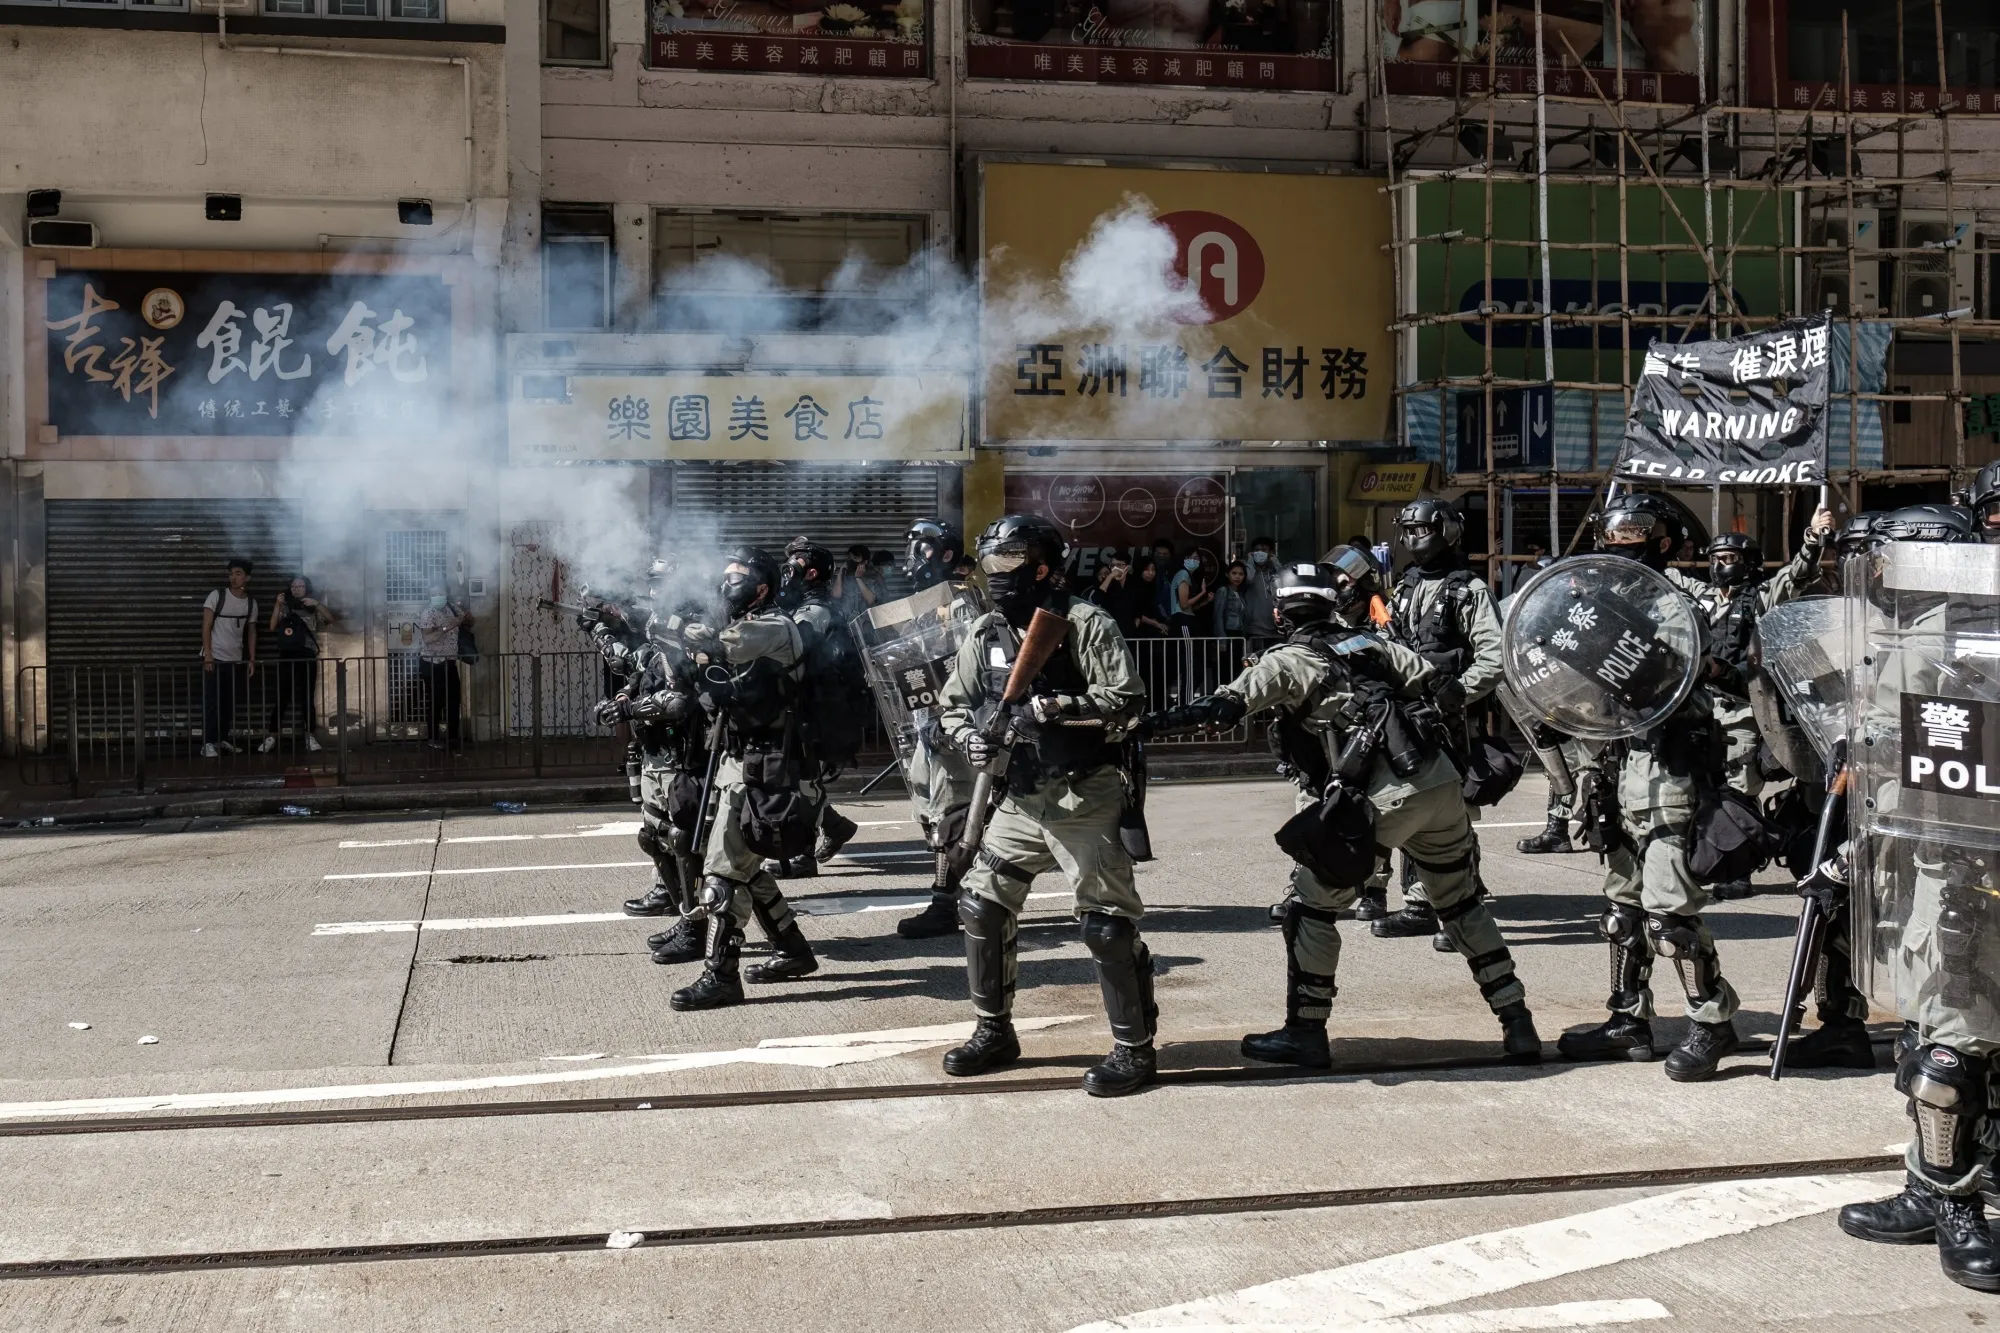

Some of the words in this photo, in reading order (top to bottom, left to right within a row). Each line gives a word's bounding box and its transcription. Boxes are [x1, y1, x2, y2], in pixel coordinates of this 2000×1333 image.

[699, 0, 788, 28] Glamour
[814, 27, 881, 38] CONSULTS
[1071, 7, 1155, 42] Glamour
[660, 41, 920, 69] 唯美美容減肥顧問
[1088, 38, 1122, 47] BEAU
[1034, 53, 1275, 79] 唯美美容減肥顧問
[44, 283, 176, 419] 吉祥
[197, 300, 428, 387] 餛飩
[1730, 326, 1827, 384] 催淚煙
[1014, 344, 1370, 400] 亞洲聯合財務
[608, 394, 884, 441] 樂園美食店
[1662, 407, 1798, 440] WARNING
[1550, 601, 1598, 651] 警察
[1596, 629, 1653, 690] POLICE
[1920, 701, 1970, 751] 警
[1910, 755, 2000, 795] POL
